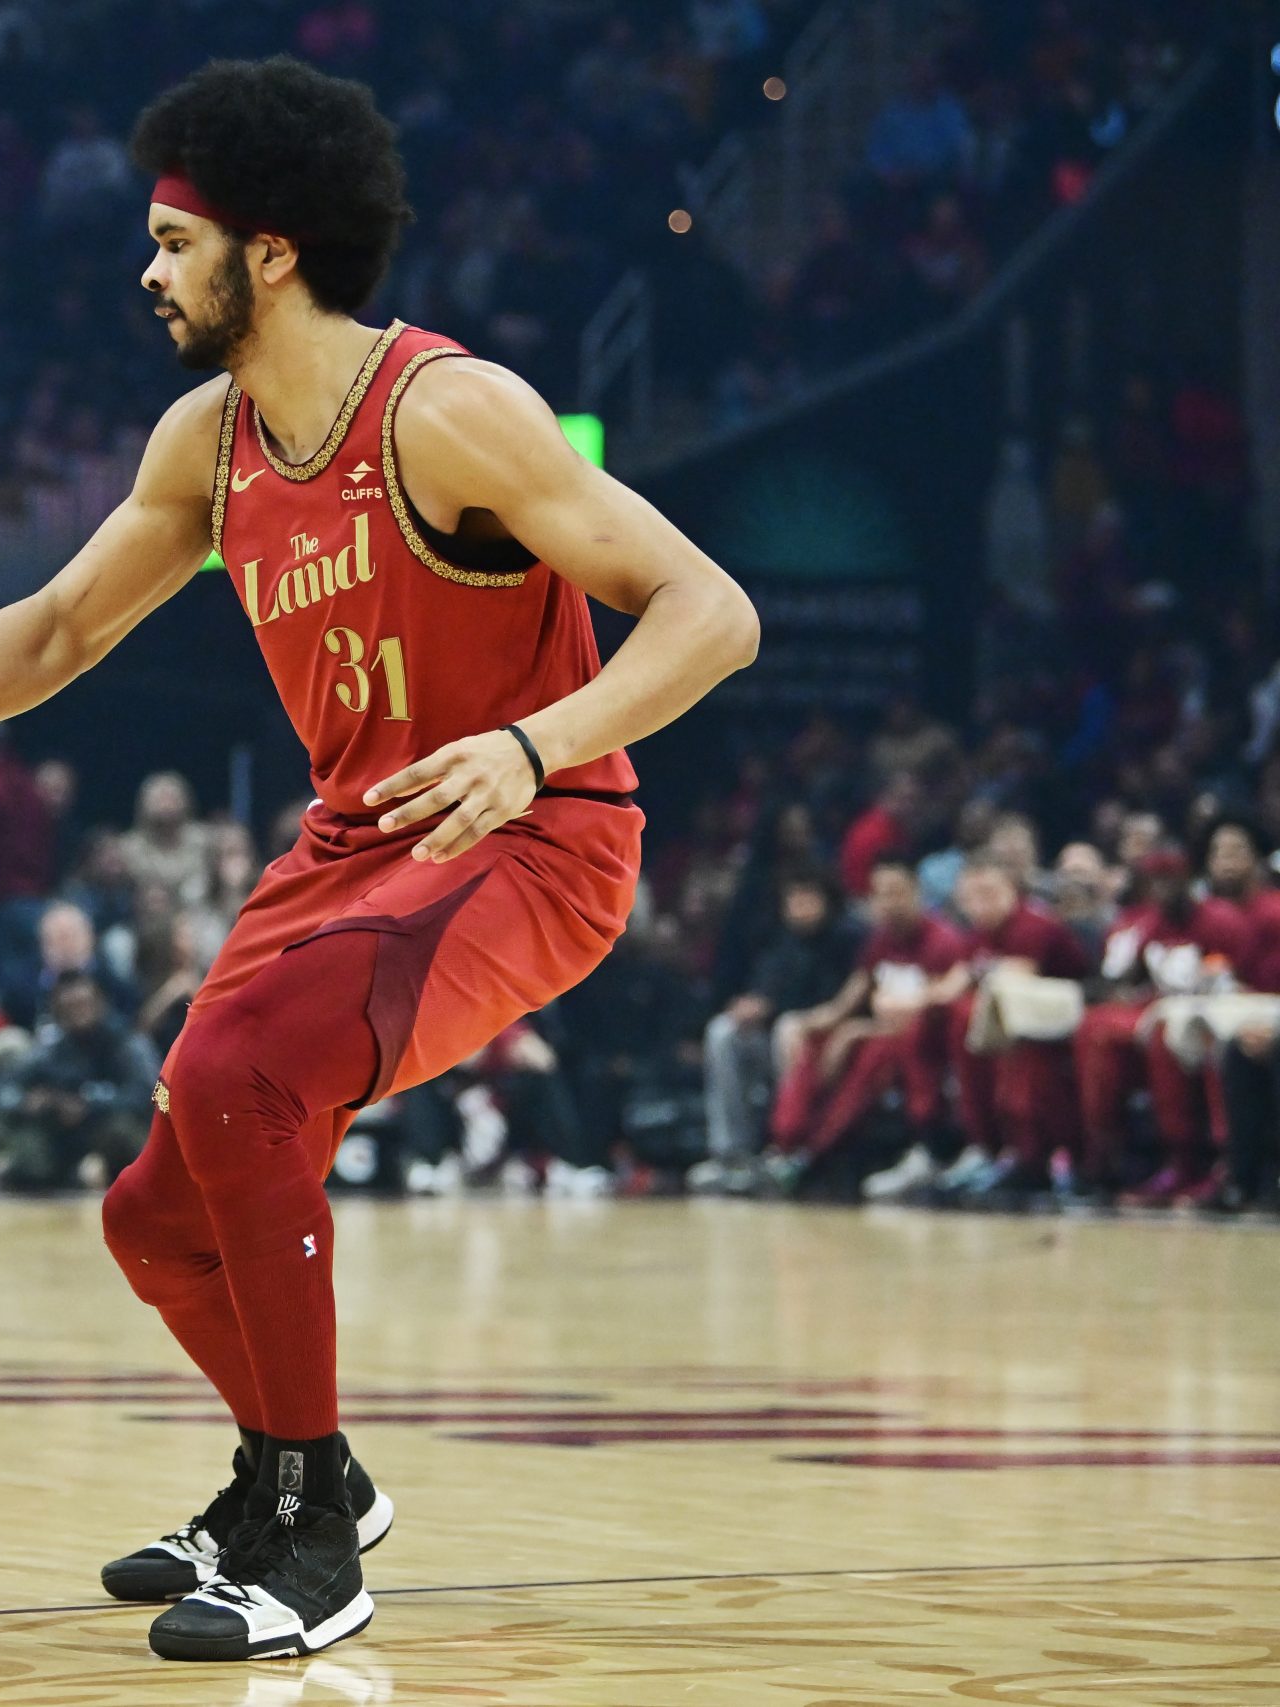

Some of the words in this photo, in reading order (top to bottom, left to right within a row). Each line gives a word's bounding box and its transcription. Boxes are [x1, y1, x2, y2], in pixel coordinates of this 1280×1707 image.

[341, 487, 383, 501] CLIFFS
[241, 512, 376, 627] Land
[290, 532, 319, 561] The
[324, 626, 413, 722] 31
